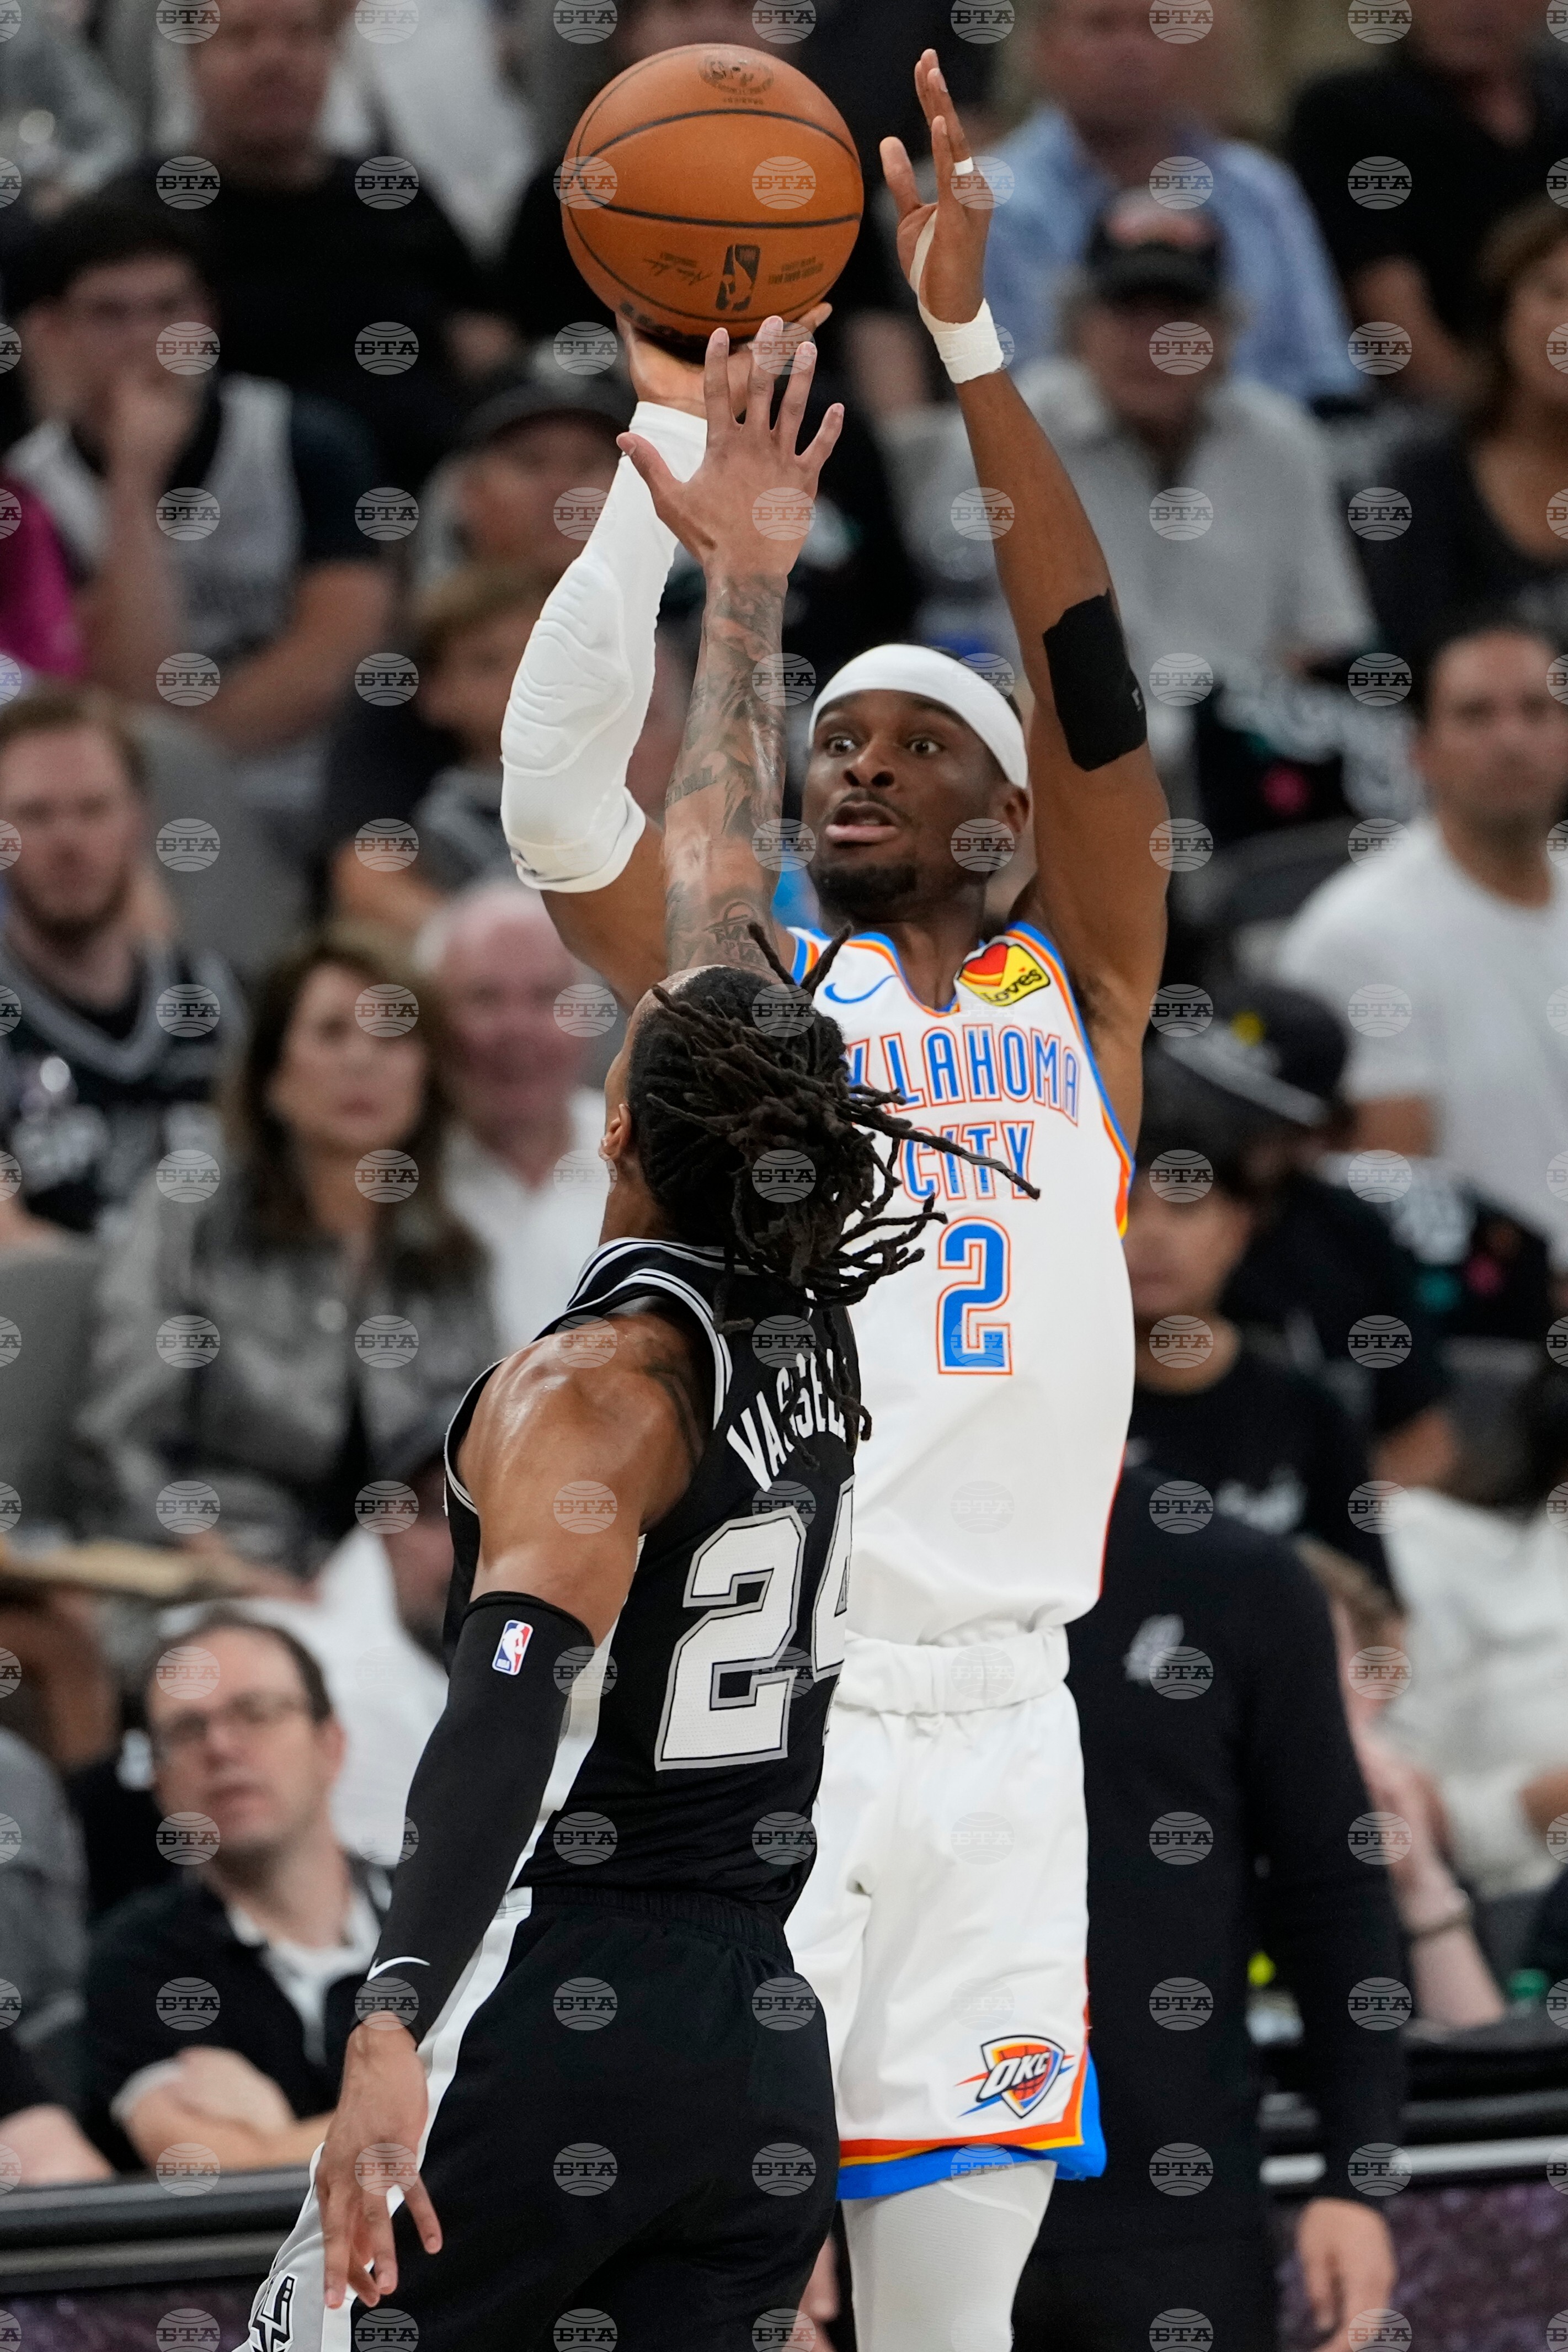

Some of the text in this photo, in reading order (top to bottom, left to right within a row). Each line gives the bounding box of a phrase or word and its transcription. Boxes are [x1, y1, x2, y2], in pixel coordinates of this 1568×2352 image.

[840, 1024, 1080, 1127] LAHOMA
[899, 1120, 1034, 1202] CITY
[936, 1216, 1012, 1375] 2
[977, 2051, 1050, 2102] OKC
